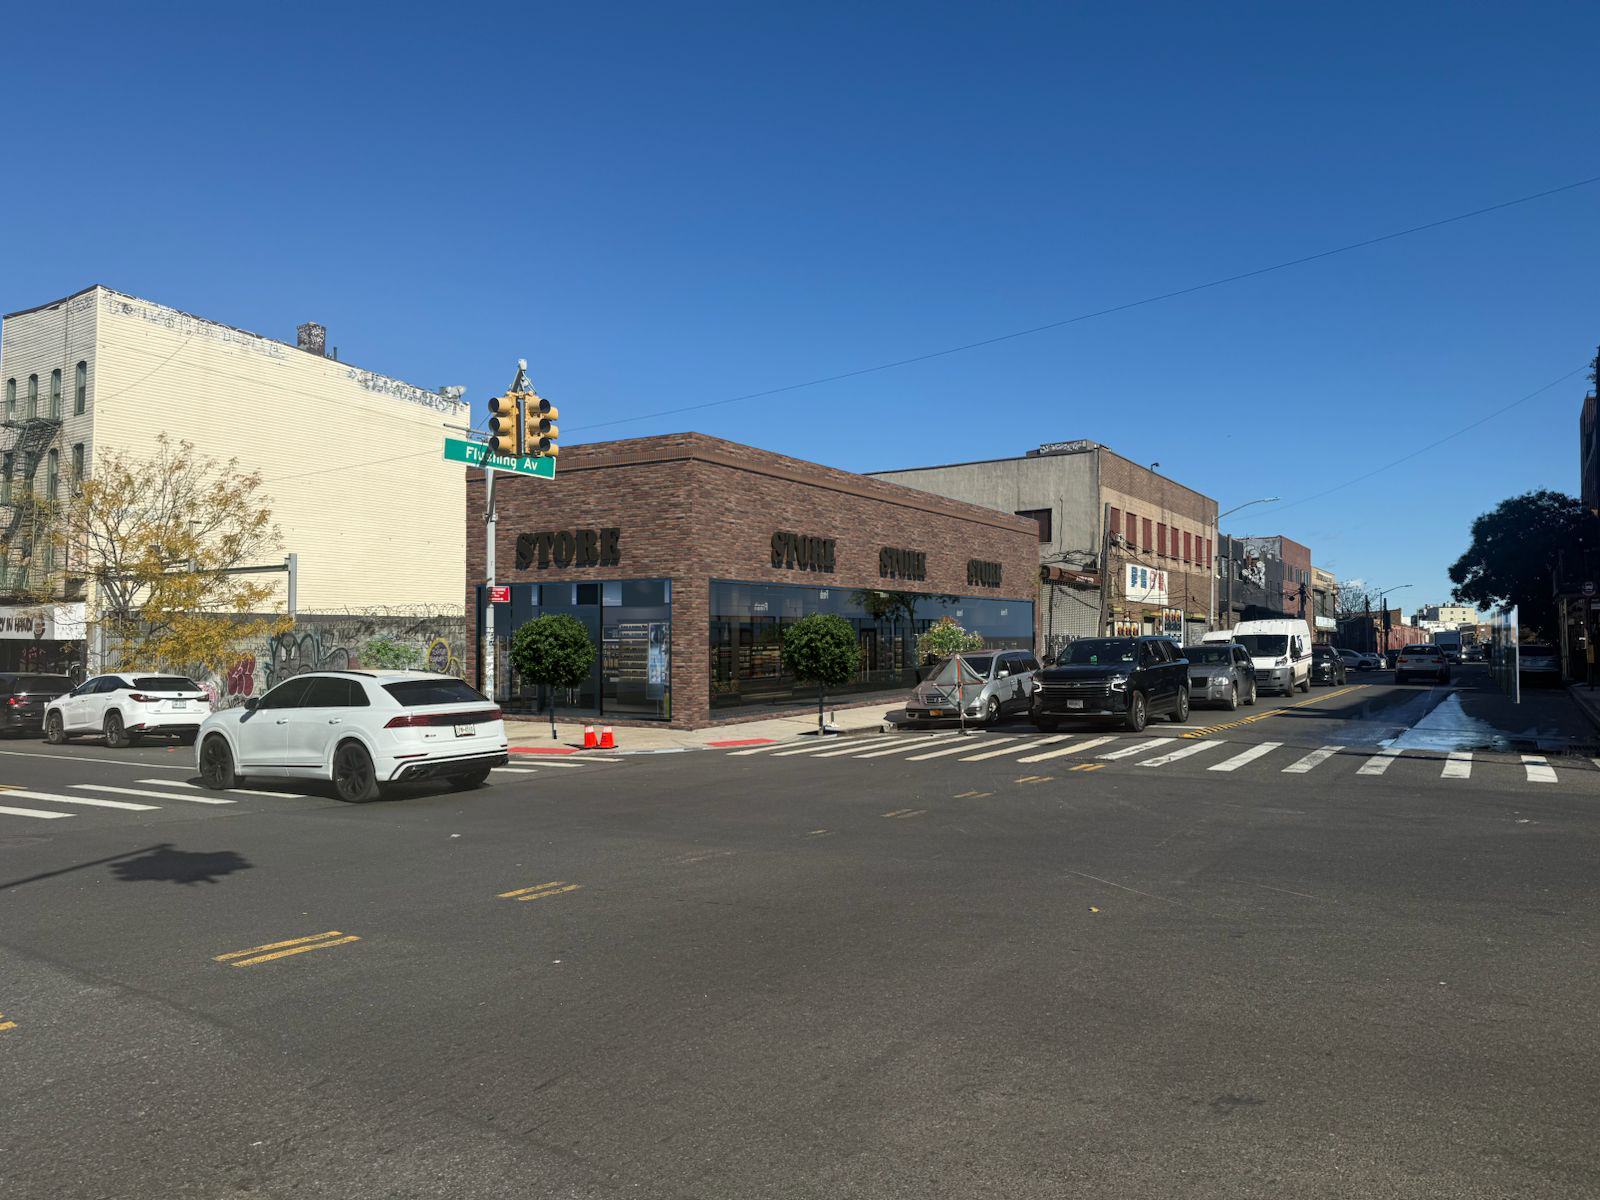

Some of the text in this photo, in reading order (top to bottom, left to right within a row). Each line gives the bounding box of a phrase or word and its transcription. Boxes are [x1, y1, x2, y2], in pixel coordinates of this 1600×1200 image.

[523, 457, 538, 471] Av
[516, 528, 620, 566] STORE
[771, 531, 836, 567] STORE
[879, 546, 926, 576] STORE
[967, 558, 1002, 583] STORE
